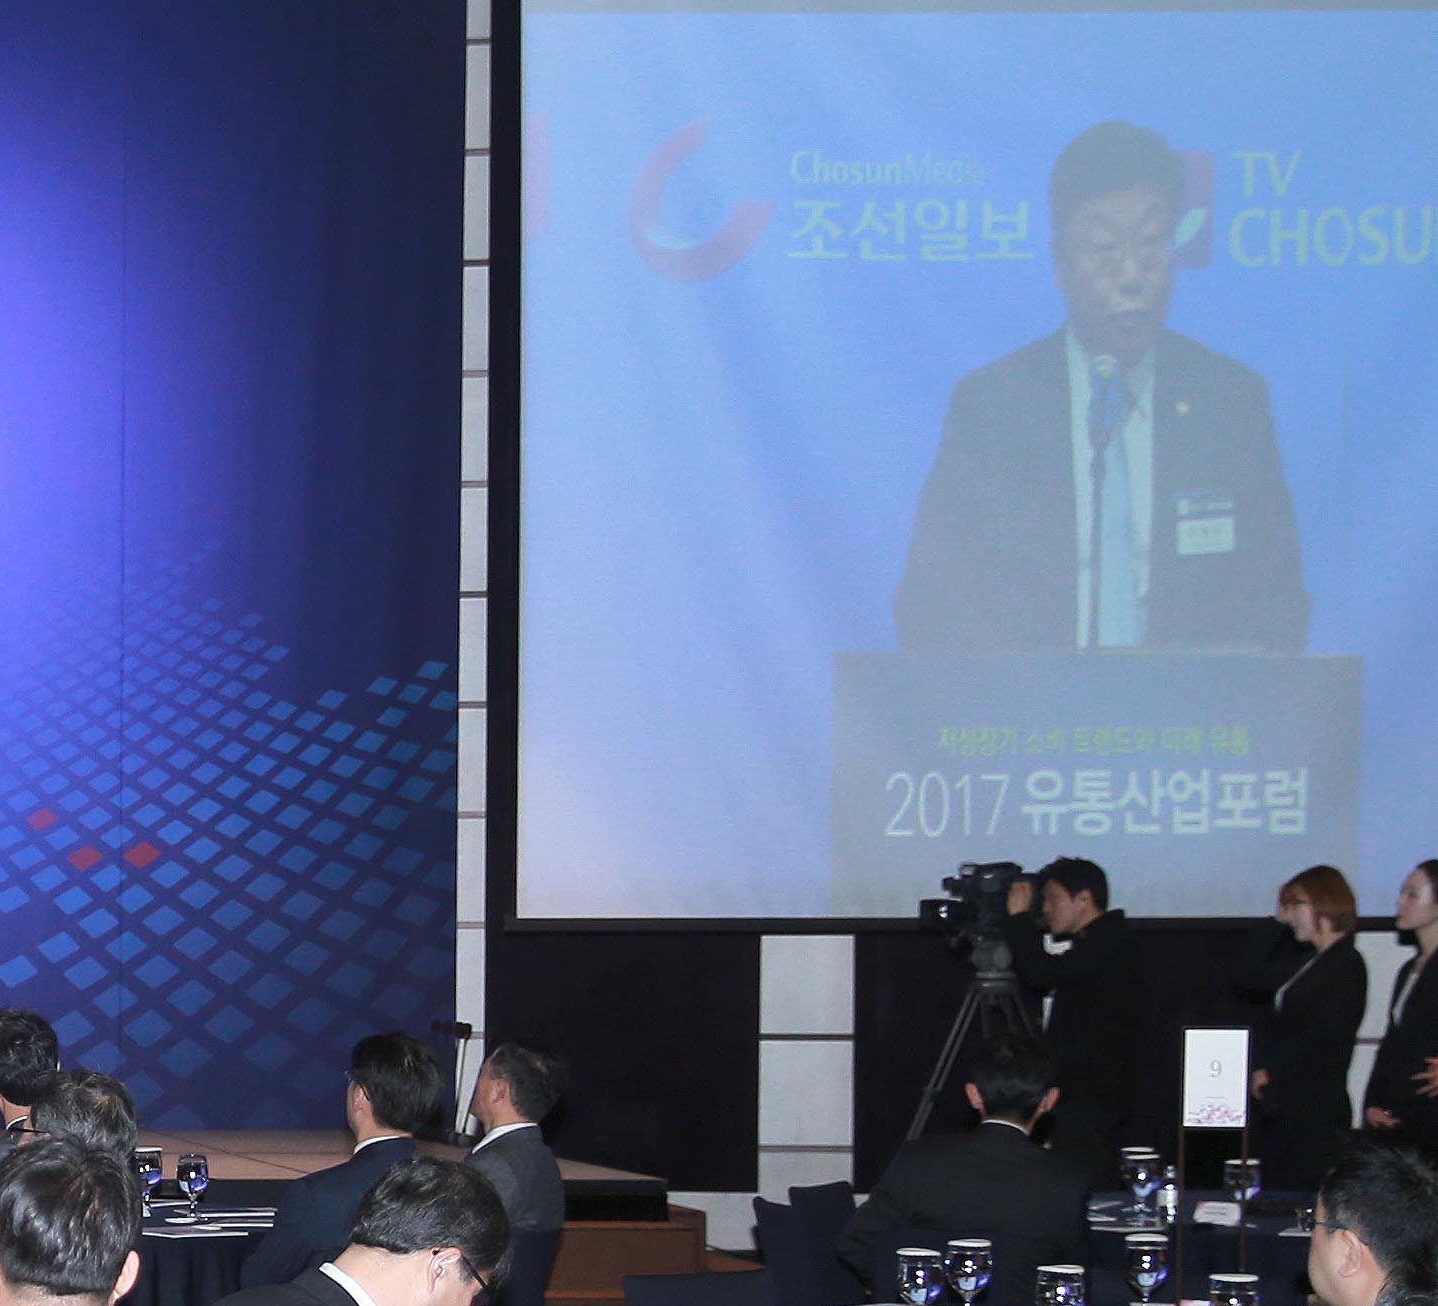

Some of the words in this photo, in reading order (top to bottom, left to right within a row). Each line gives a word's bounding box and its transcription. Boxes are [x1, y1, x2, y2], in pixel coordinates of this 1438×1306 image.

[1231, 150, 1303, 198] TV
[787, 198, 1035, 261] 조선일보
[1229, 206, 1438, 268] CHOSU
[883, 770, 1012, 839] 2017
[1022, 766, 1309, 837] 유통산업포럼
[1210, 1059, 1223, 1078] 9
